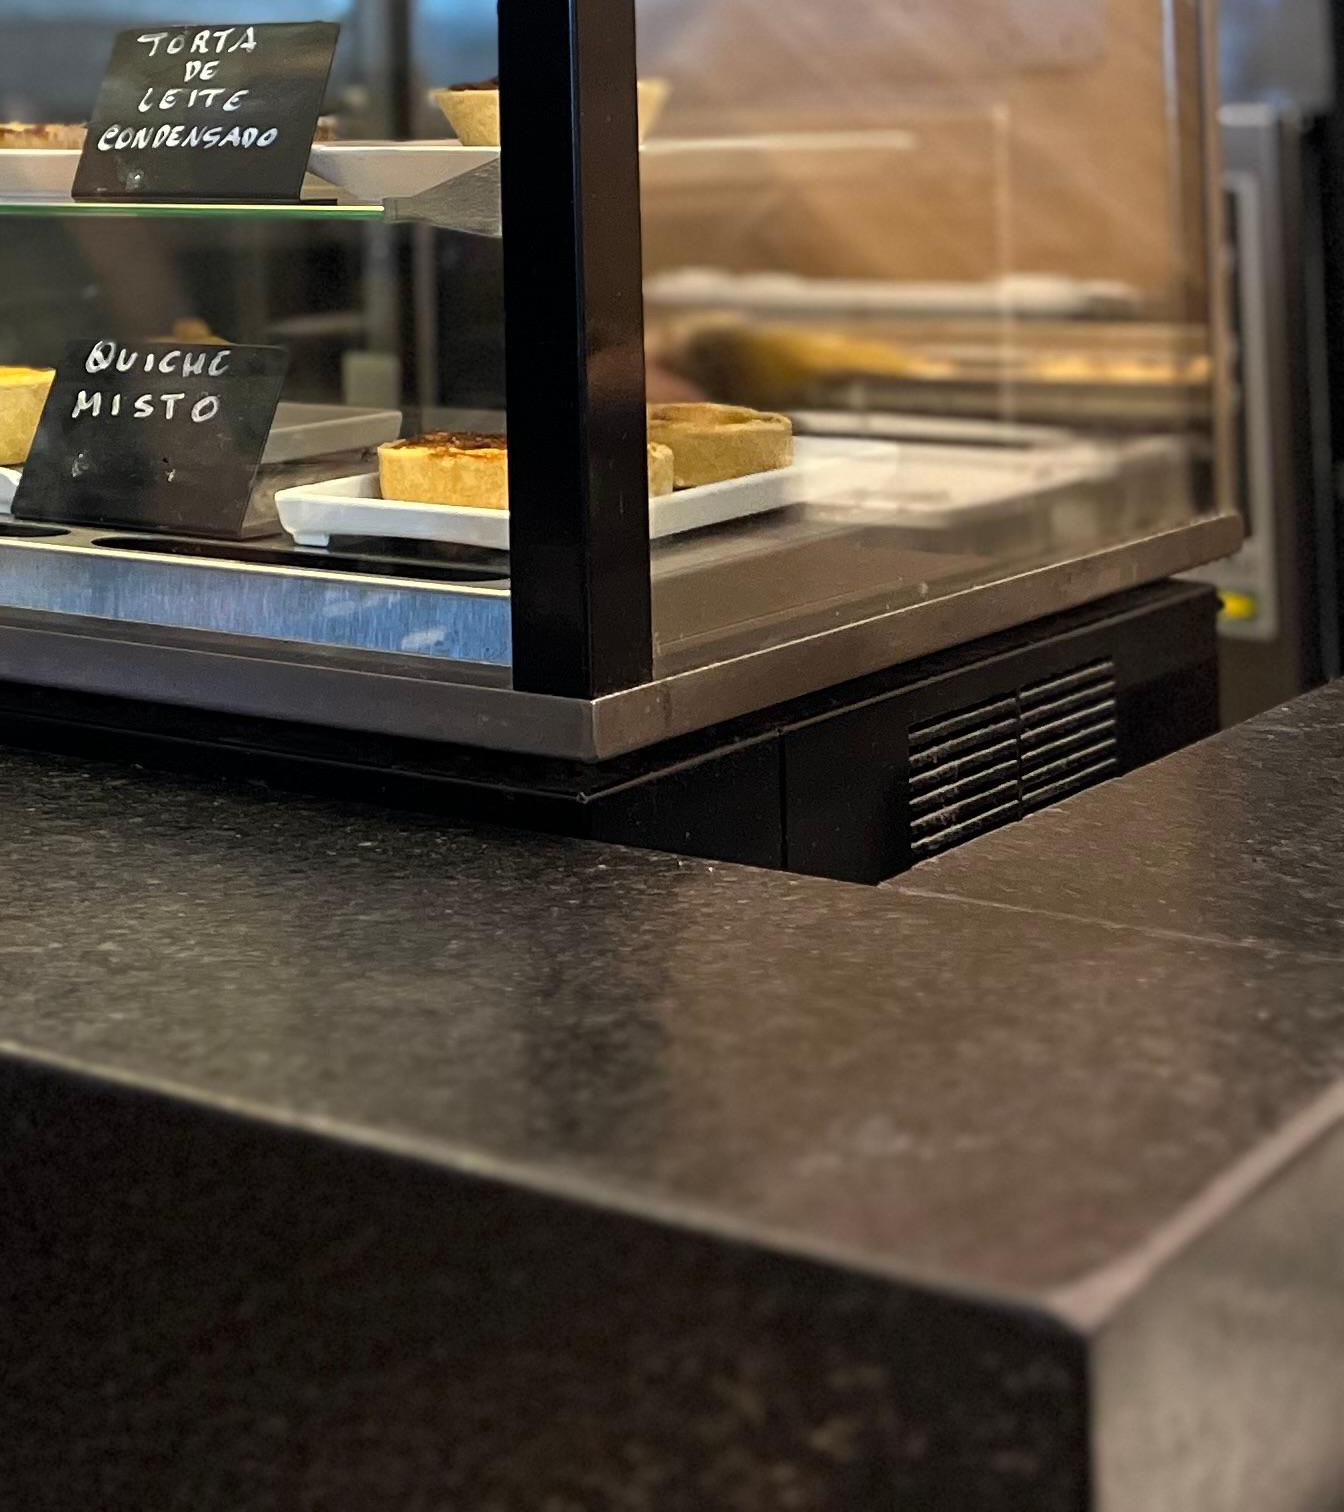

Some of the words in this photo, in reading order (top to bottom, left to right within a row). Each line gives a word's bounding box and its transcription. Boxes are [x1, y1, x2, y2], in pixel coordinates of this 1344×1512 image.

[136, 26, 257, 57] TORTA
[183, 60, 221, 83] DE
[138, 88, 250, 113] LEITE
[97, 124, 278, 152] CONDENSADO
[71, 390, 221, 423] MISTO
